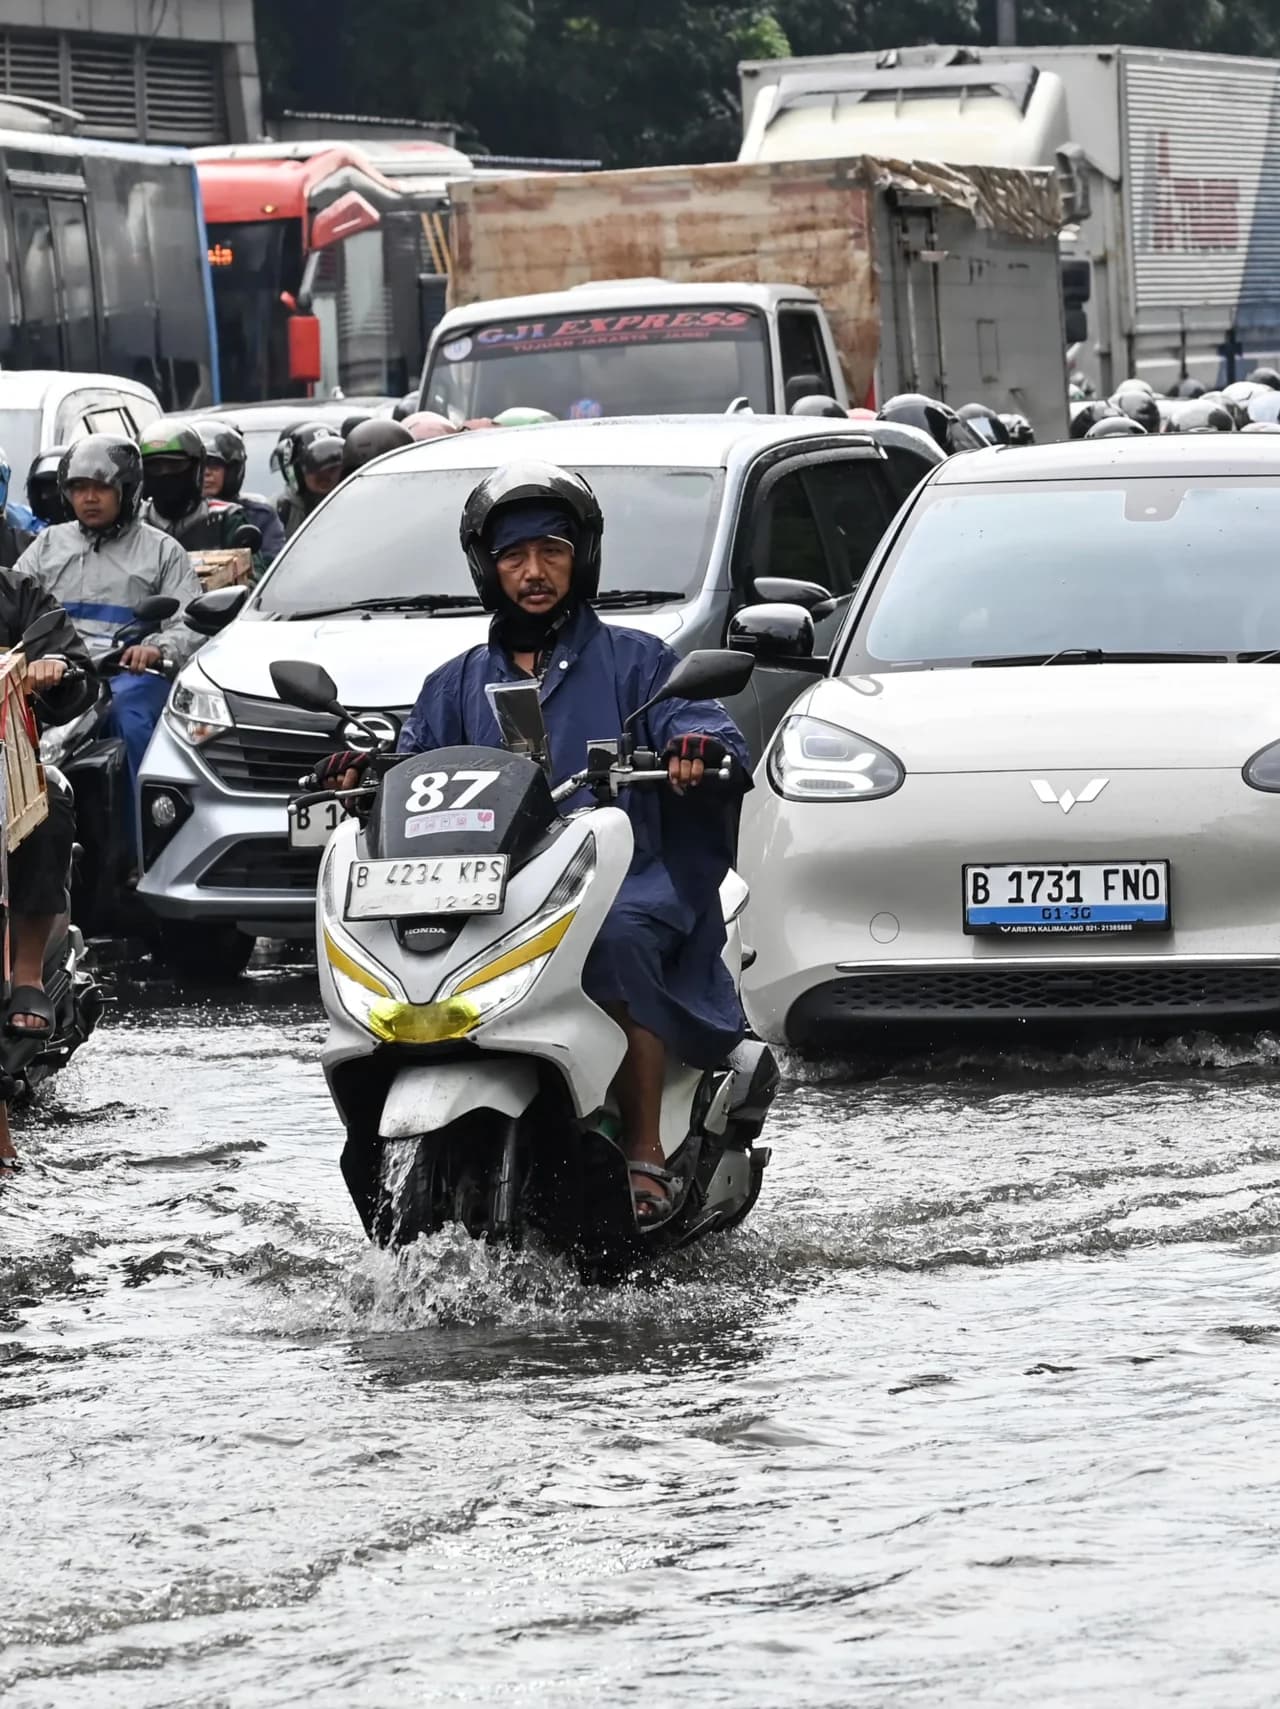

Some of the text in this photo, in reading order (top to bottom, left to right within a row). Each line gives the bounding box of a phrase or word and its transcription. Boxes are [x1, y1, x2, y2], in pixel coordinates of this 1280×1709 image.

[551, 311, 749, 337] EXPRESS
[405, 770, 501, 813] 87
[297, 805, 311, 830] B
[356, 860, 502, 888] B 4234 KPS
[972, 868, 1160, 904] B 1731 FNO
[404, 927, 447, 935] HONDA
[1038, 924, 1084, 932] KALIMALANG
